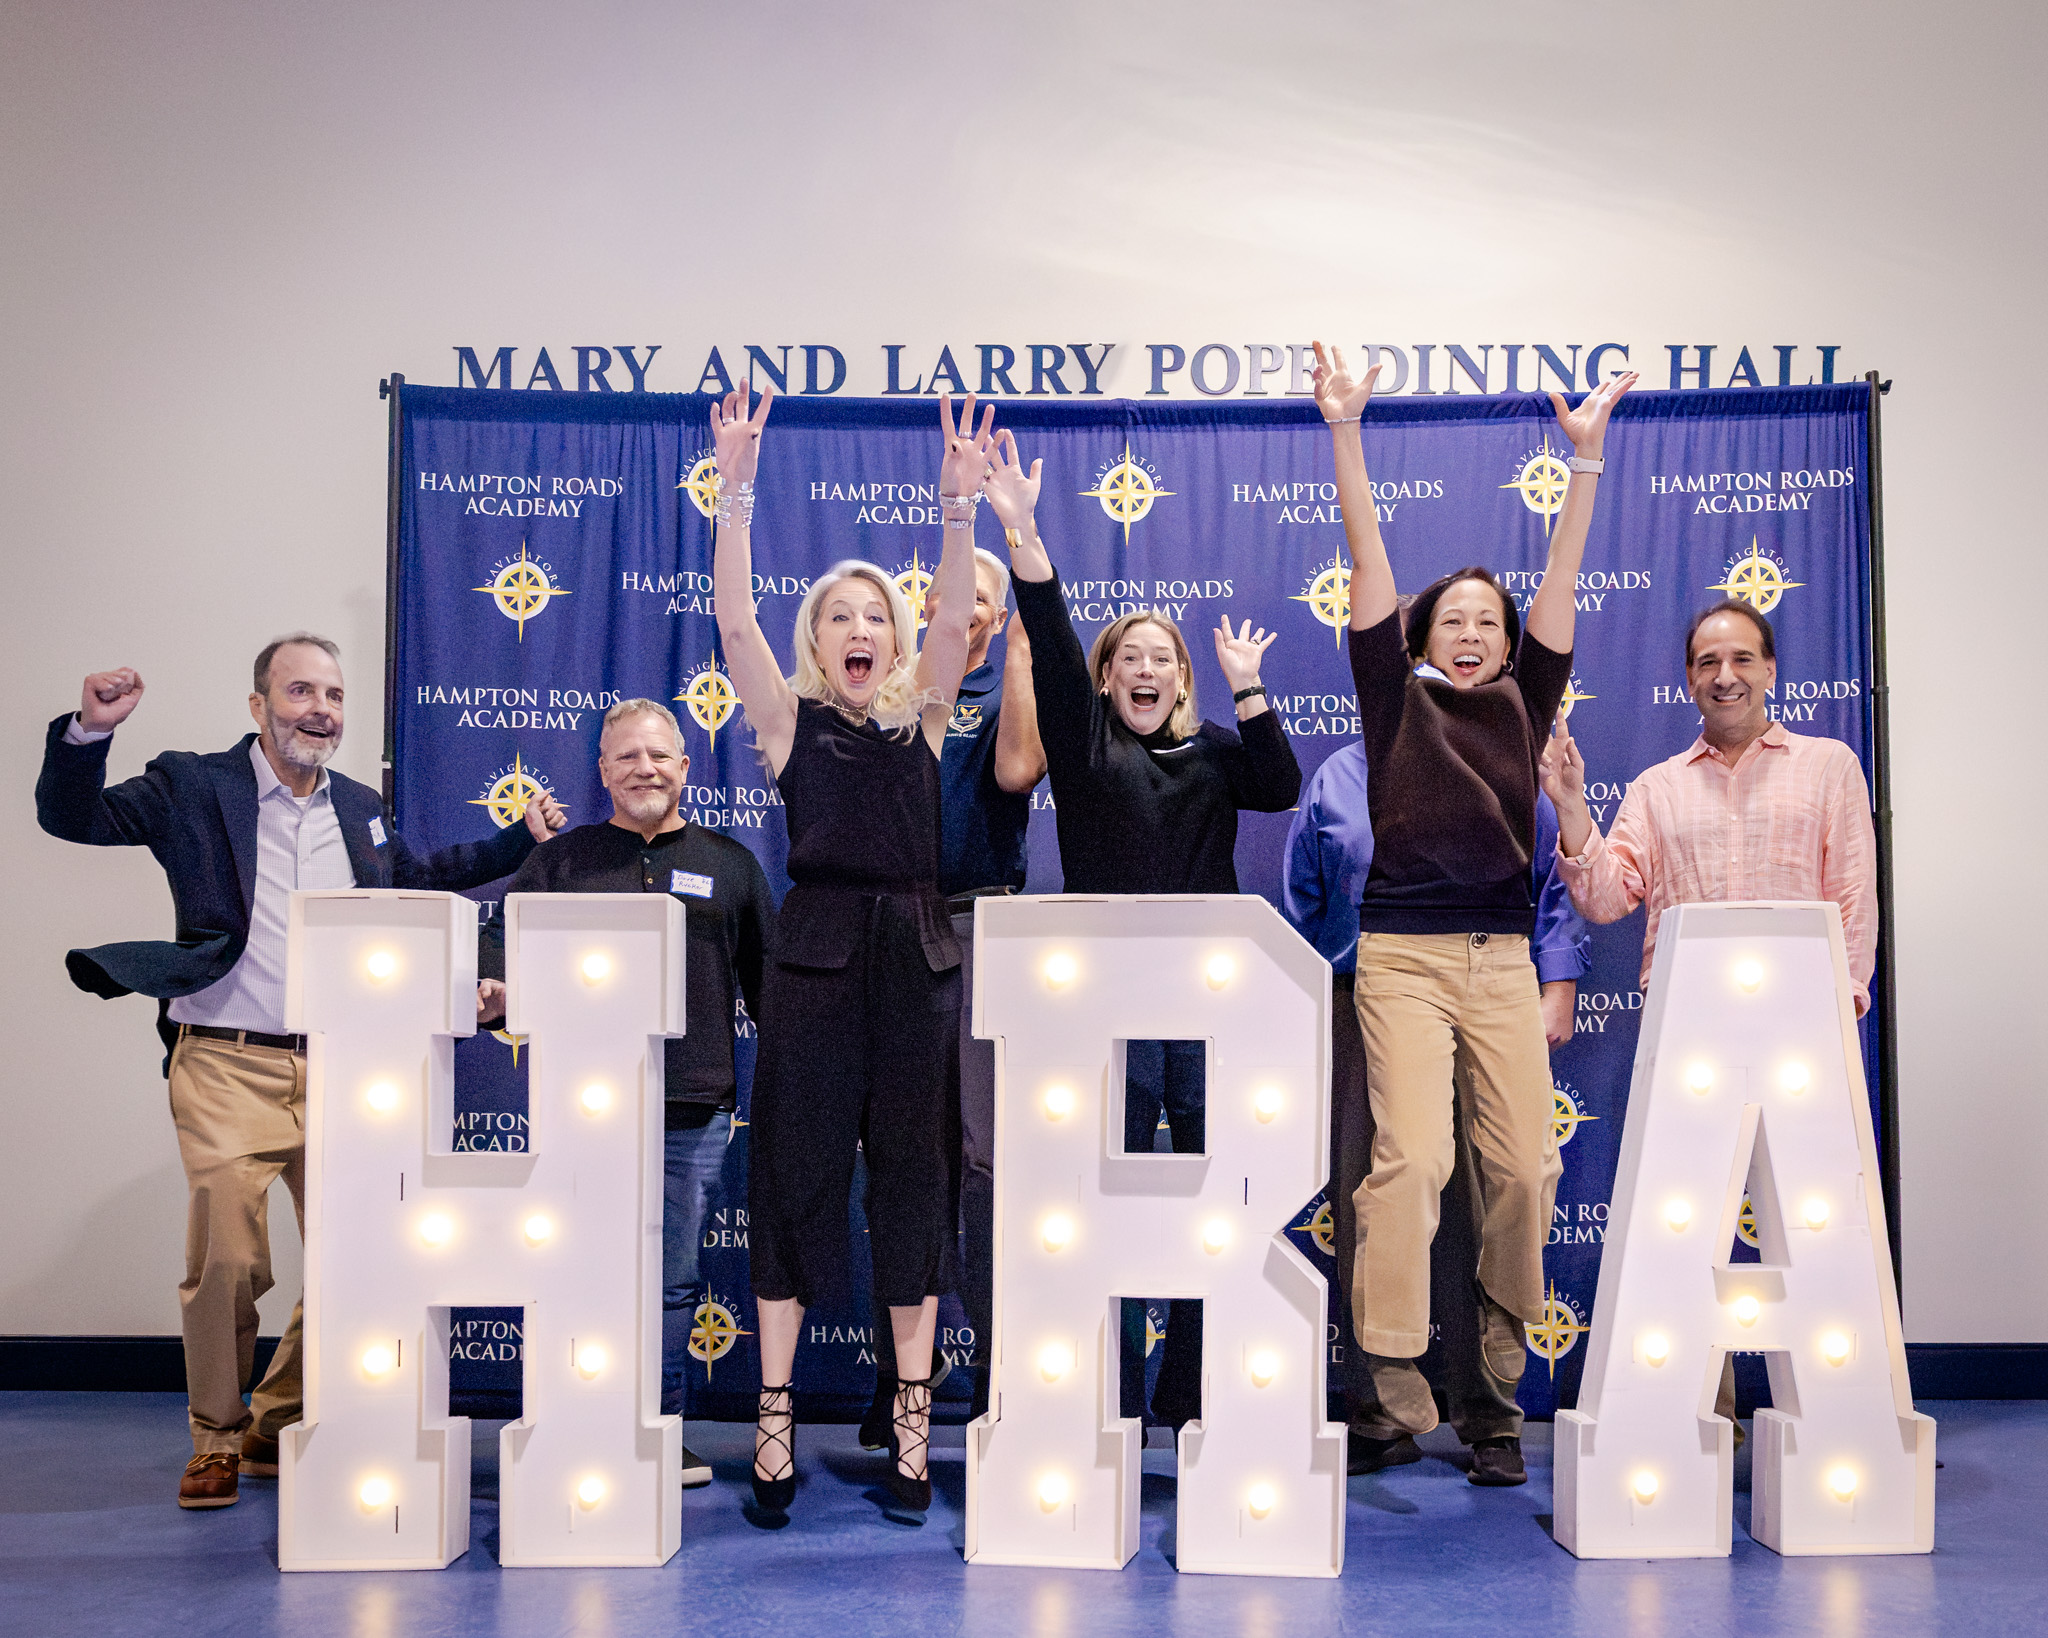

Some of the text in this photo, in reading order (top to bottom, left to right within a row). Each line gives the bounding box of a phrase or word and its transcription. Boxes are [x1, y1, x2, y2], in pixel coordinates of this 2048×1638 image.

[453, 343, 1857, 395] MARY AND LARRY POPE DINING HALL
[680, 447, 717, 483] NAVIGA
[1091, 453, 1164, 492] NAVIGATORS
[1512, 445, 1574, 482] NAVIGATO
[419, 472, 623, 497] HAMPTON ROADS
[1650, 467, 1854, 494] HAMPTON ROADS
[810, 482, 935, 502] HAMPTON
[1233, 480, 1444, 503] HAMPTO ROADS
[465, 497, 584, 518] ACADEMY
[1277, 504, 1398, 524] ACADY
[1694, 492, 1813, 515] ACADEMY
[855, 506, 944, 525] ACADE
[484, 551, 561, 591] NAVIGATORS
[1719, 547, 1792, 585] NAVIGATORS
[622, 571, 811, 596] HAMPTO OADS
[1300, 558, 1349, 596] NAVIGA
[1575, 570, 1651, 590] ROADS
[1062, 579, 1234, 600] MPTON ROADS
[665, 594, 764, 615] ACADY
[1511, 593, 1606, 612] CAMY
[678, 661, 729, 696] NAVIGAT
[417, 685, 621, 710] HAMPTON ROADS
[1785, 679, 1860, 701] ROADS
[1272, 694, 1357, 714] MPTON
[457, 709, 582, 731] ACADEMY
[1281, 716, 1362, 735] ACADE
[735, 787, 786, 806] ROA
[1582, 782, 1633, 801] ROA
[678, 807, 767, 828] ADEMY
[1578, 992, 1644, 1011] ROAD
[453, 1112, 529, 1131] MPTON
[455, 1133, 526, 1152] ACAD
[1546, 1225, 1607, 1245] DEMY
[1543, 1290, 1588, 1327] GATORS
[450, 1320, 524, 1340] MPTON
[450, 1341, 523, 1361] ACAD
